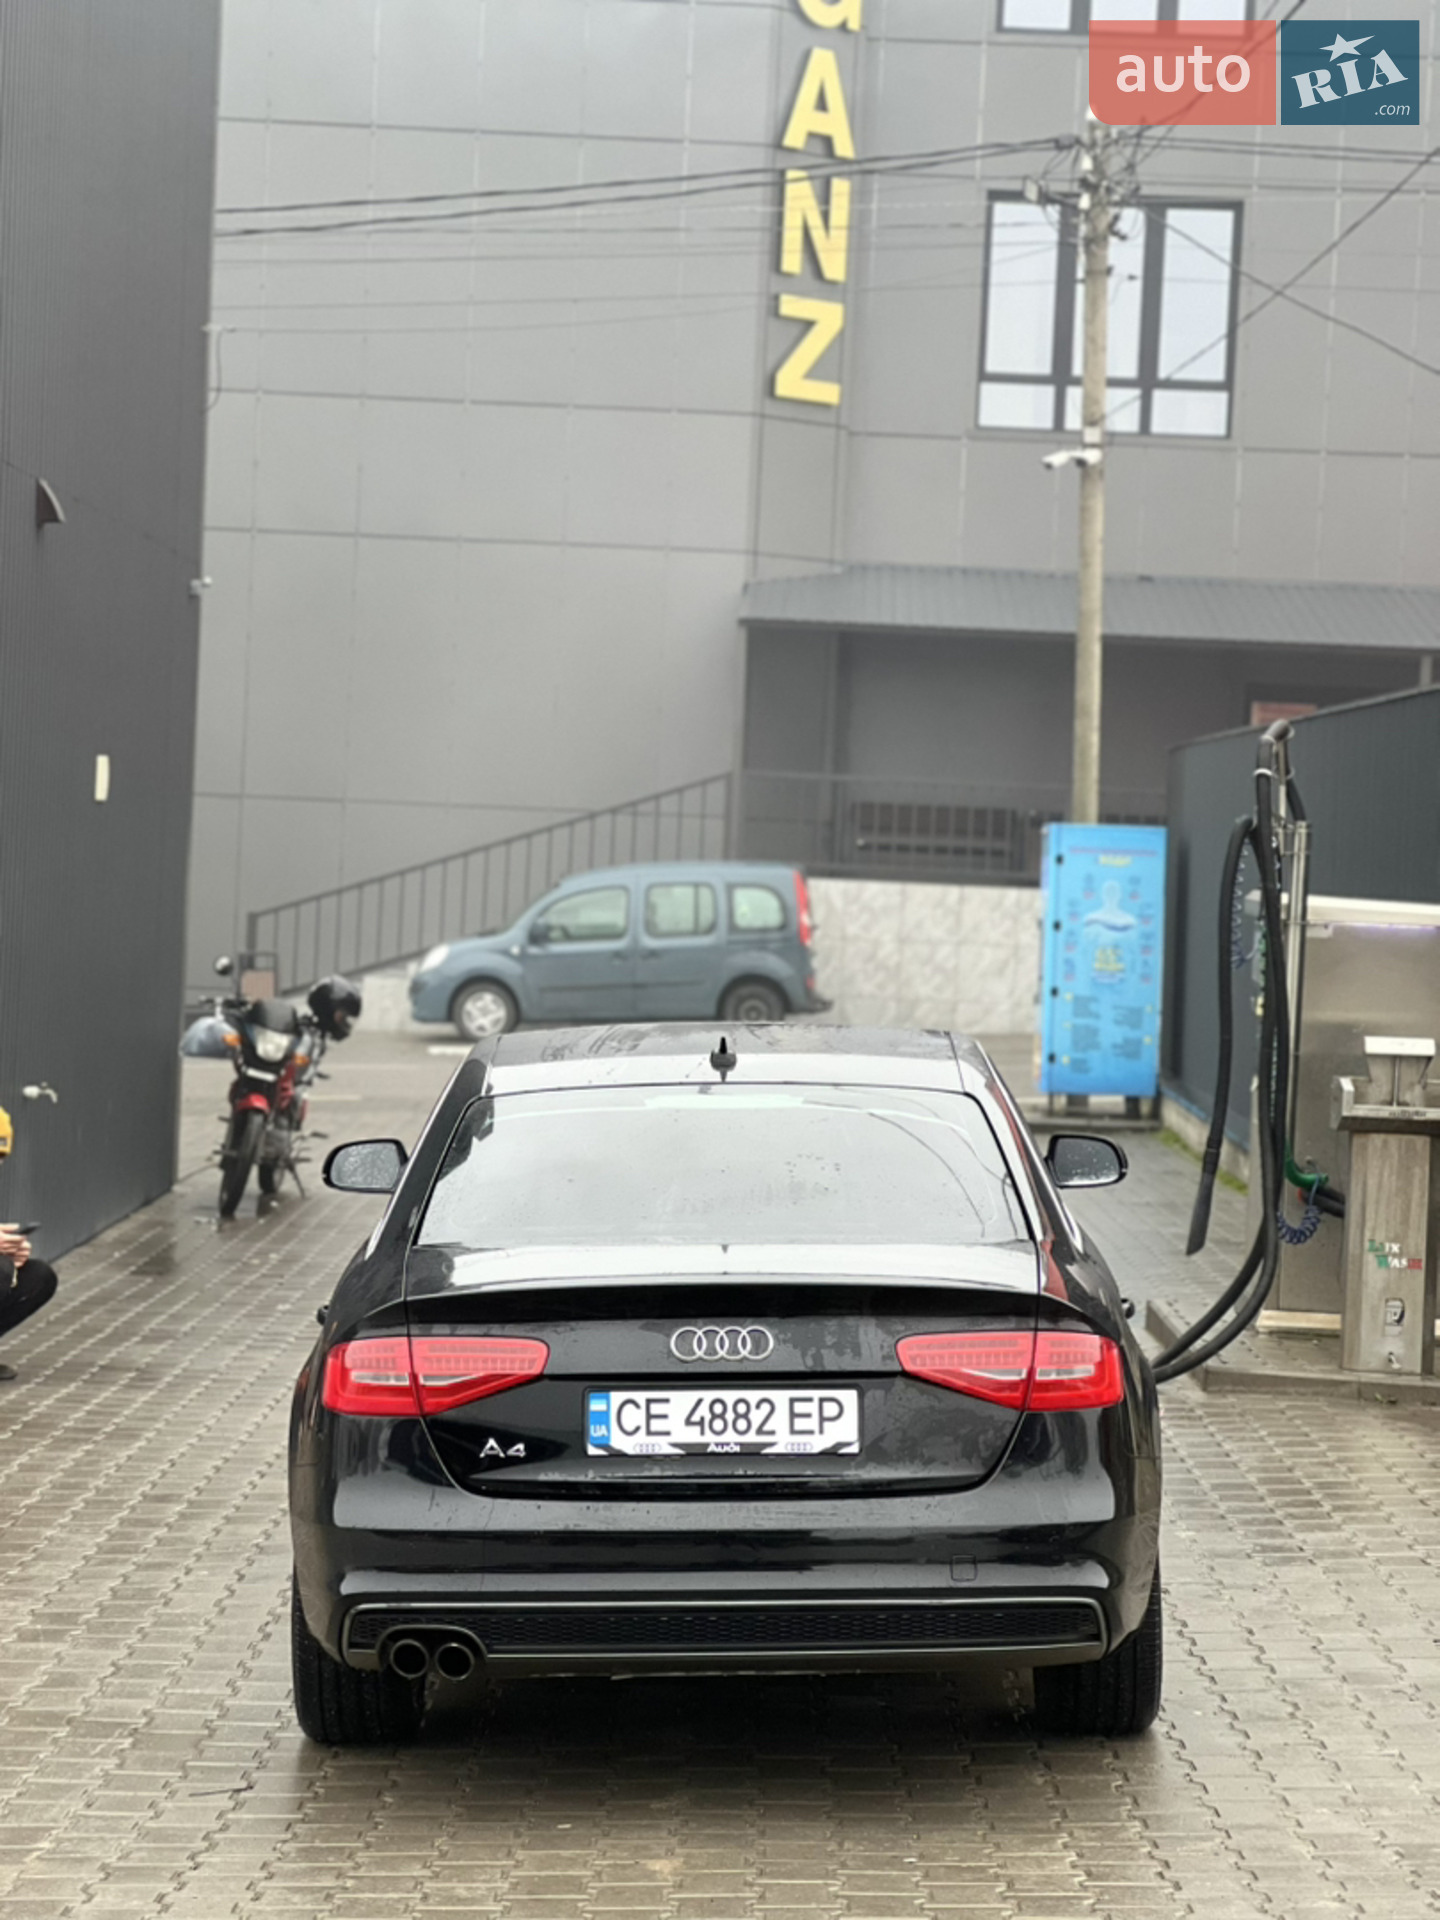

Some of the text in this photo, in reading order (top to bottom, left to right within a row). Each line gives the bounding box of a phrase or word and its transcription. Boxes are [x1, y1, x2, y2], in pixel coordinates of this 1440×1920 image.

[616, 1397, 844, 1436] CE 4882 EP
[591, 1425, 609, 1437] UA
[479, 1437, 526, 1458] A4
